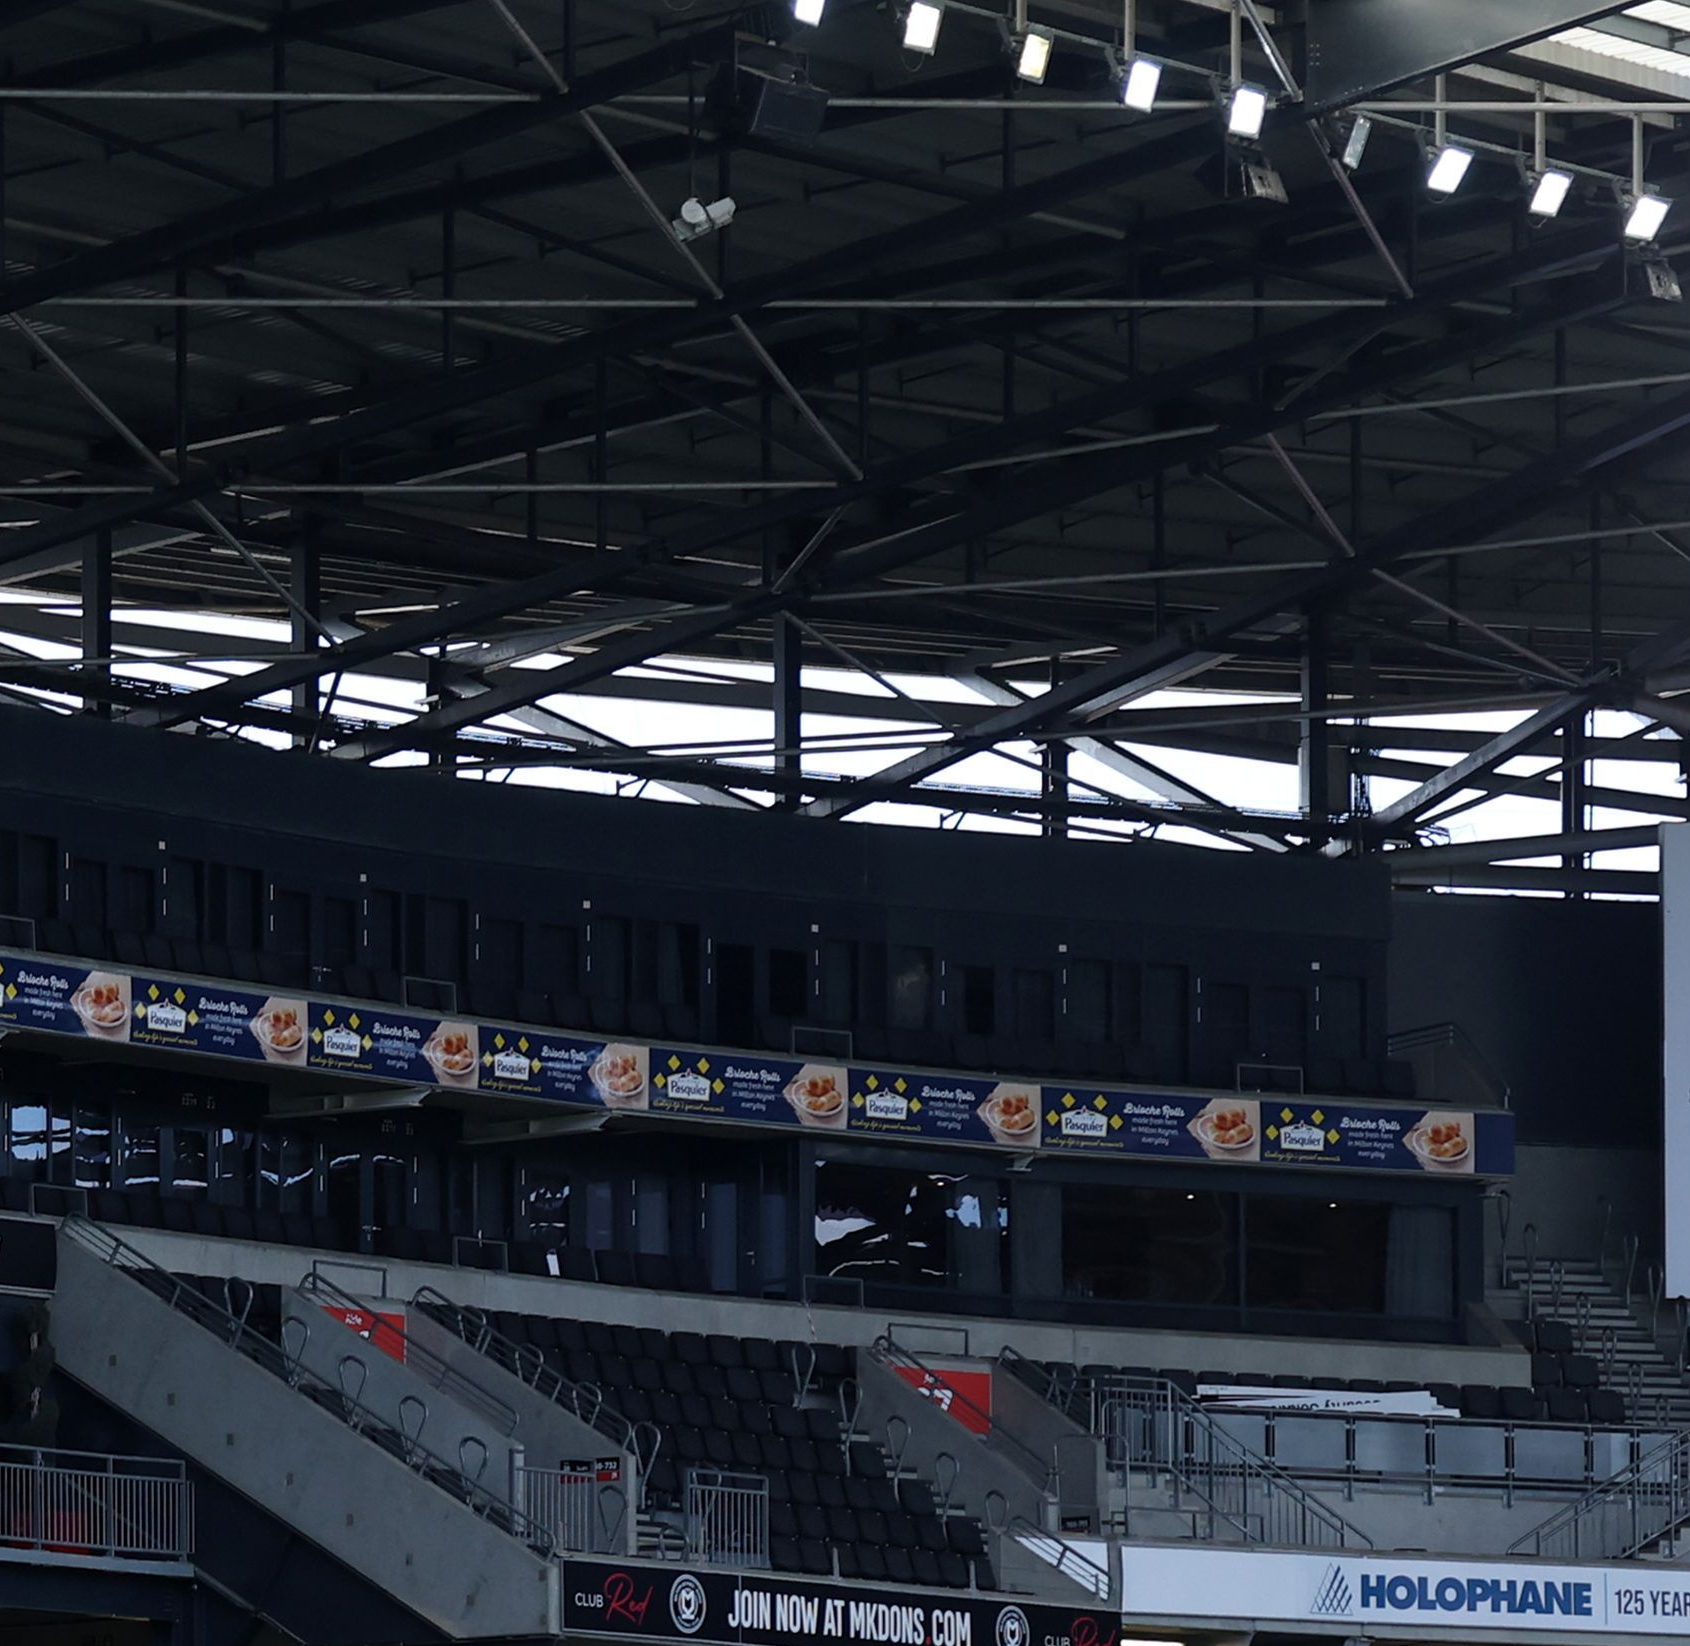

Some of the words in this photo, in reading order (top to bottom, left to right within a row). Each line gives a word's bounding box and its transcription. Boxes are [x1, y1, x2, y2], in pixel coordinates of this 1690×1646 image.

[1123, 1102, 1160, 1117] Brioche
[1161, 1105, 1185, 1120] Rolls
[1064, 1115, 1106, 1134] Pasquier
[1341, 1117, 1376, 1130] Brioche
[1377, 1120, 1401, 1132] Rolls
[1282, 1131, 1321, 1148] Pasquier
[574, 1592, 604, 1608] CLUB
[604, 1572, 653, 1625] Red
[1360, 1574, 1593, 1616] HOLOPHANE
[1614, 1589, 1644, 1616] 125
[728, 1589, 771, 1630] JOIN
[776, 1595, 818, 1635] NOW
[823, 1598, 845, 1637] AT
